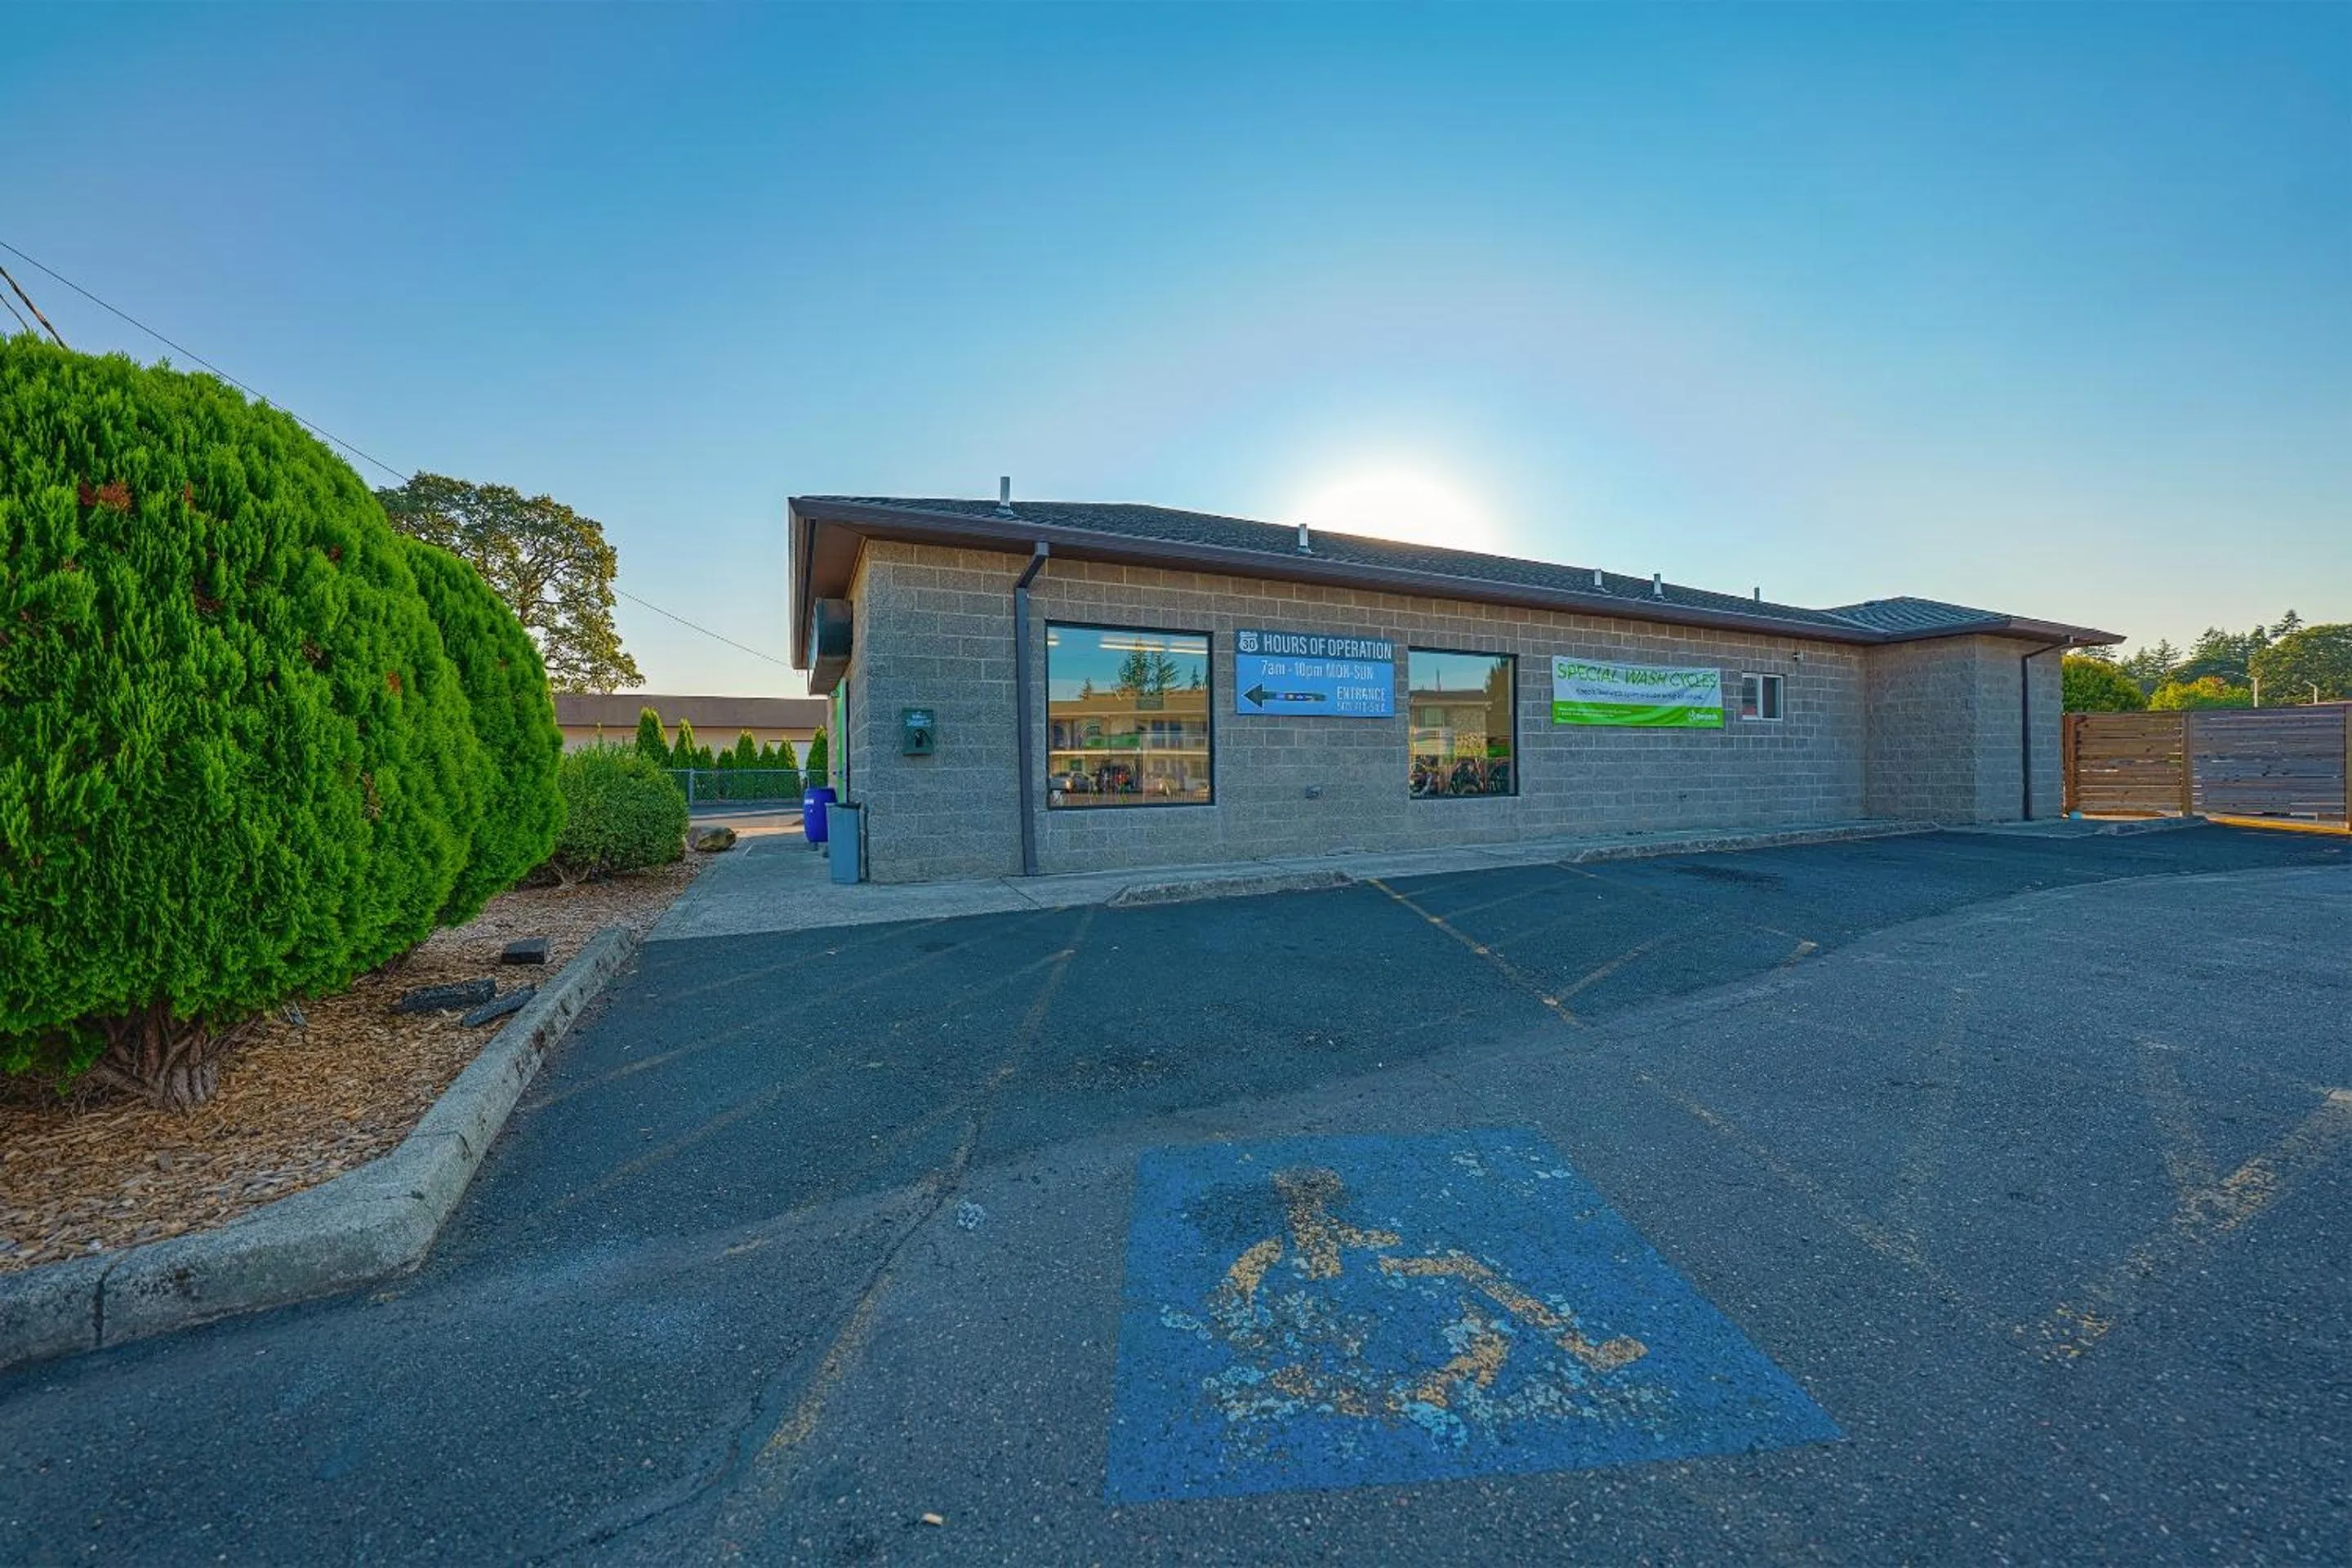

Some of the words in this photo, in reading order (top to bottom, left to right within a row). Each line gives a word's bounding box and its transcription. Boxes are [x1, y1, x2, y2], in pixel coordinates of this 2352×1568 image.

[1242, 639, 1255, 650] 30
[1264, 633, 1307, 654] HOURS
[1310, 637, 1326, 656] OF
[1328, 639, 1392, 660] OPERATION
[1261, 659, 1285, 676] 7am
[1294, 661, 1323, 679] 10pm
[1557, 662, 1619, 683] SPECIAL
[1625, 669, 1668, 686] WASH
[1669, 671, 1719, 689] CYCLES
[1337, 685, 1387, 702] ENTRANCE
